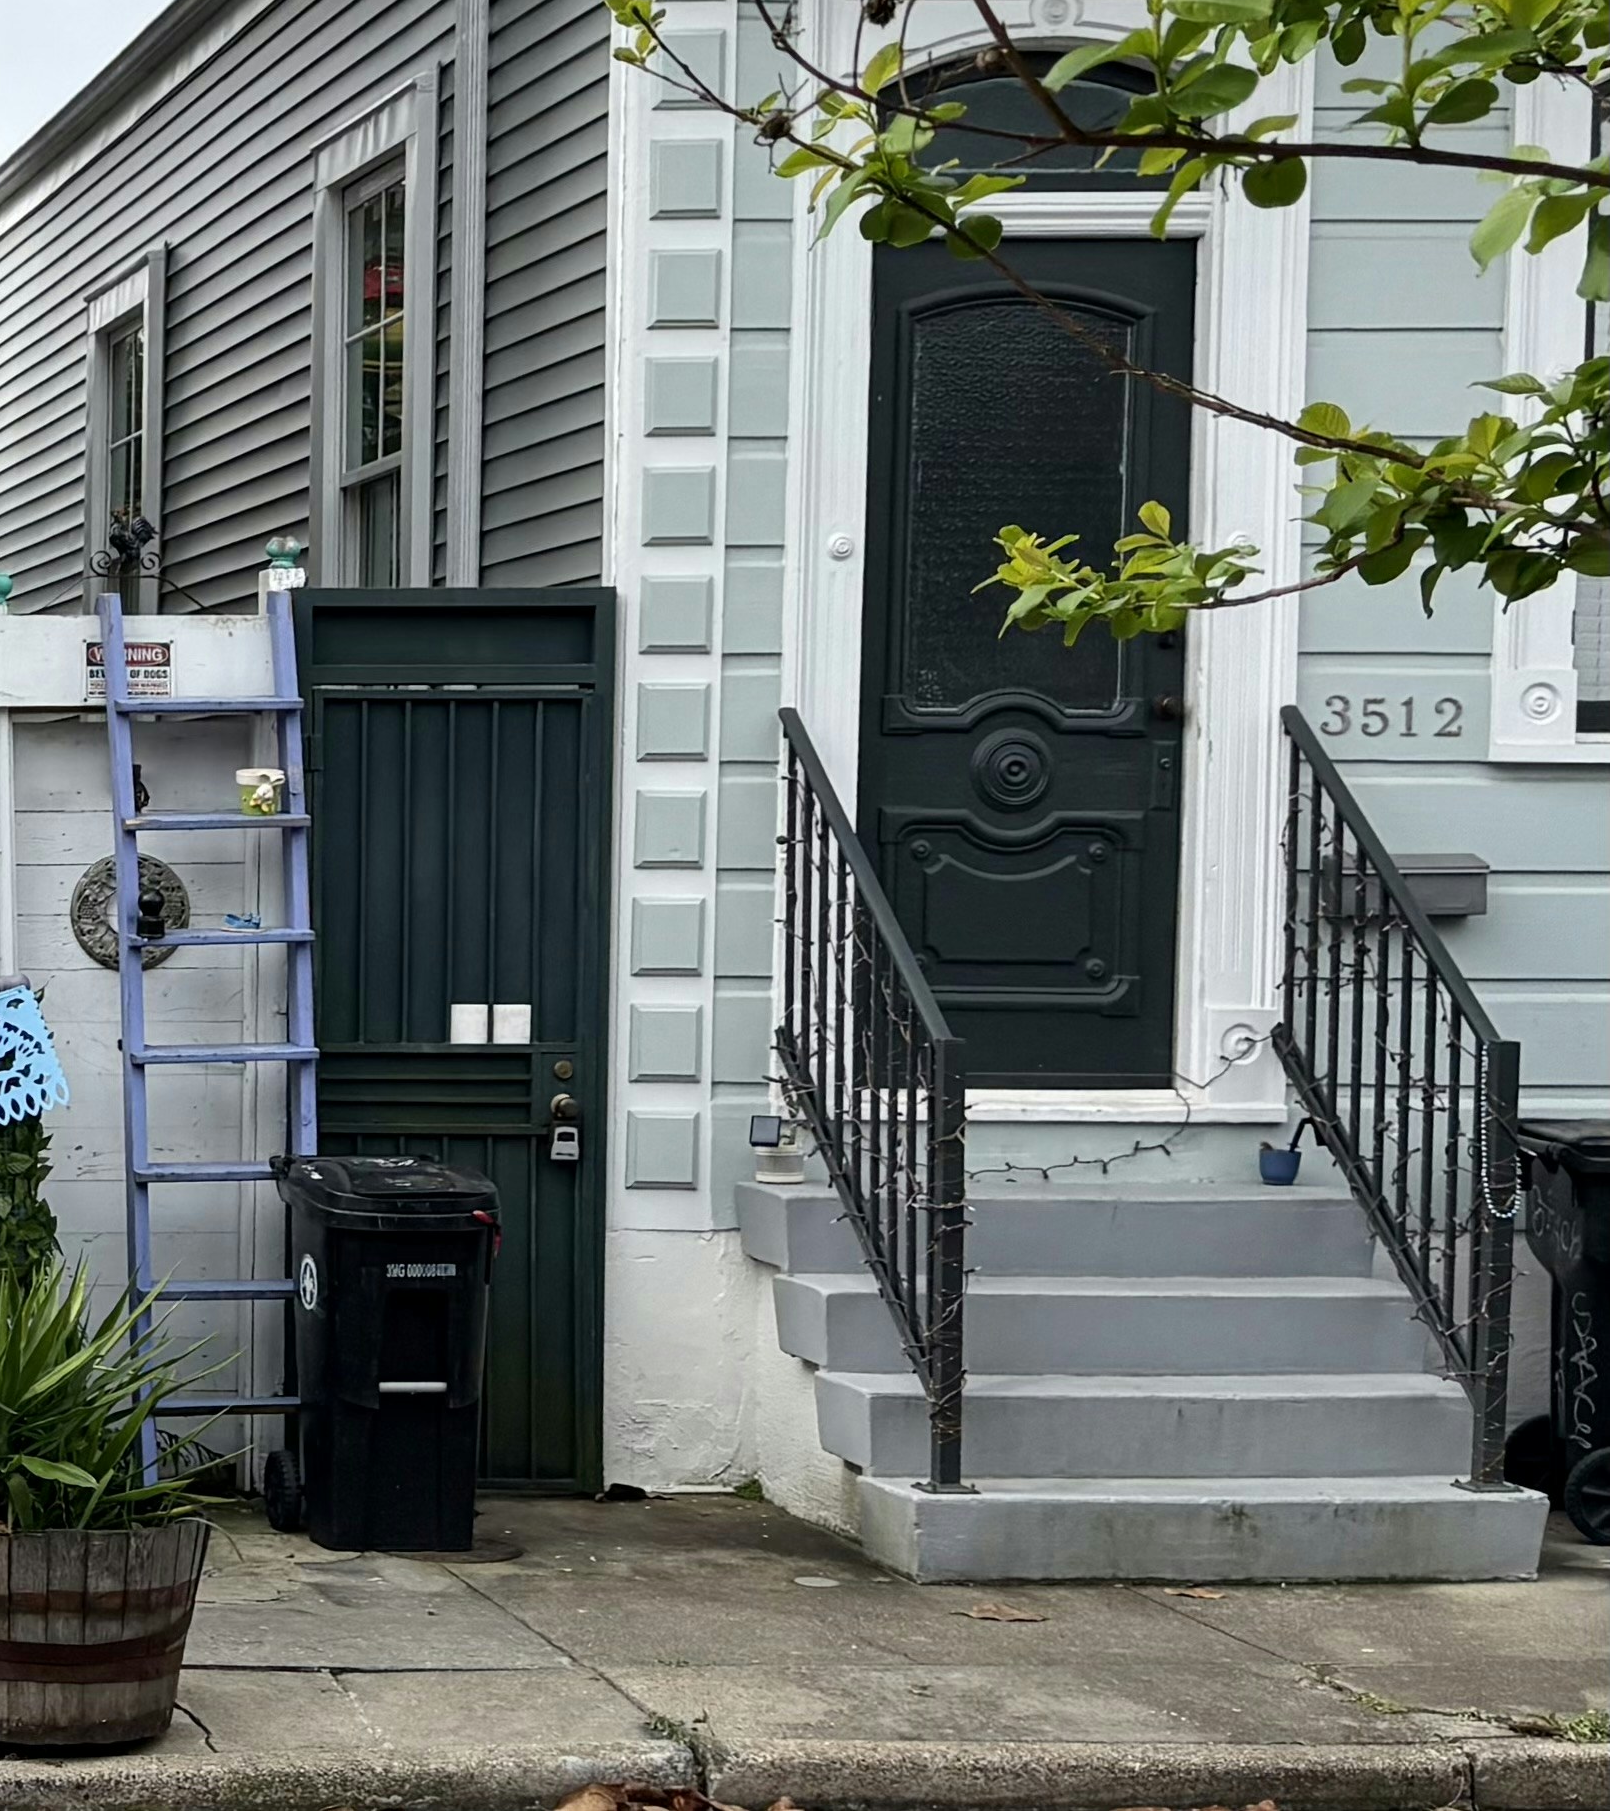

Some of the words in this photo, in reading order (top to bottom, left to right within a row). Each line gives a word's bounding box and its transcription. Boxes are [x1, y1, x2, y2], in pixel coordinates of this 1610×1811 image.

[130, 670, 140, 679] OF
[144, 670, 168, 679] DOGS
[1320, 695, 1463, 737] 3512
